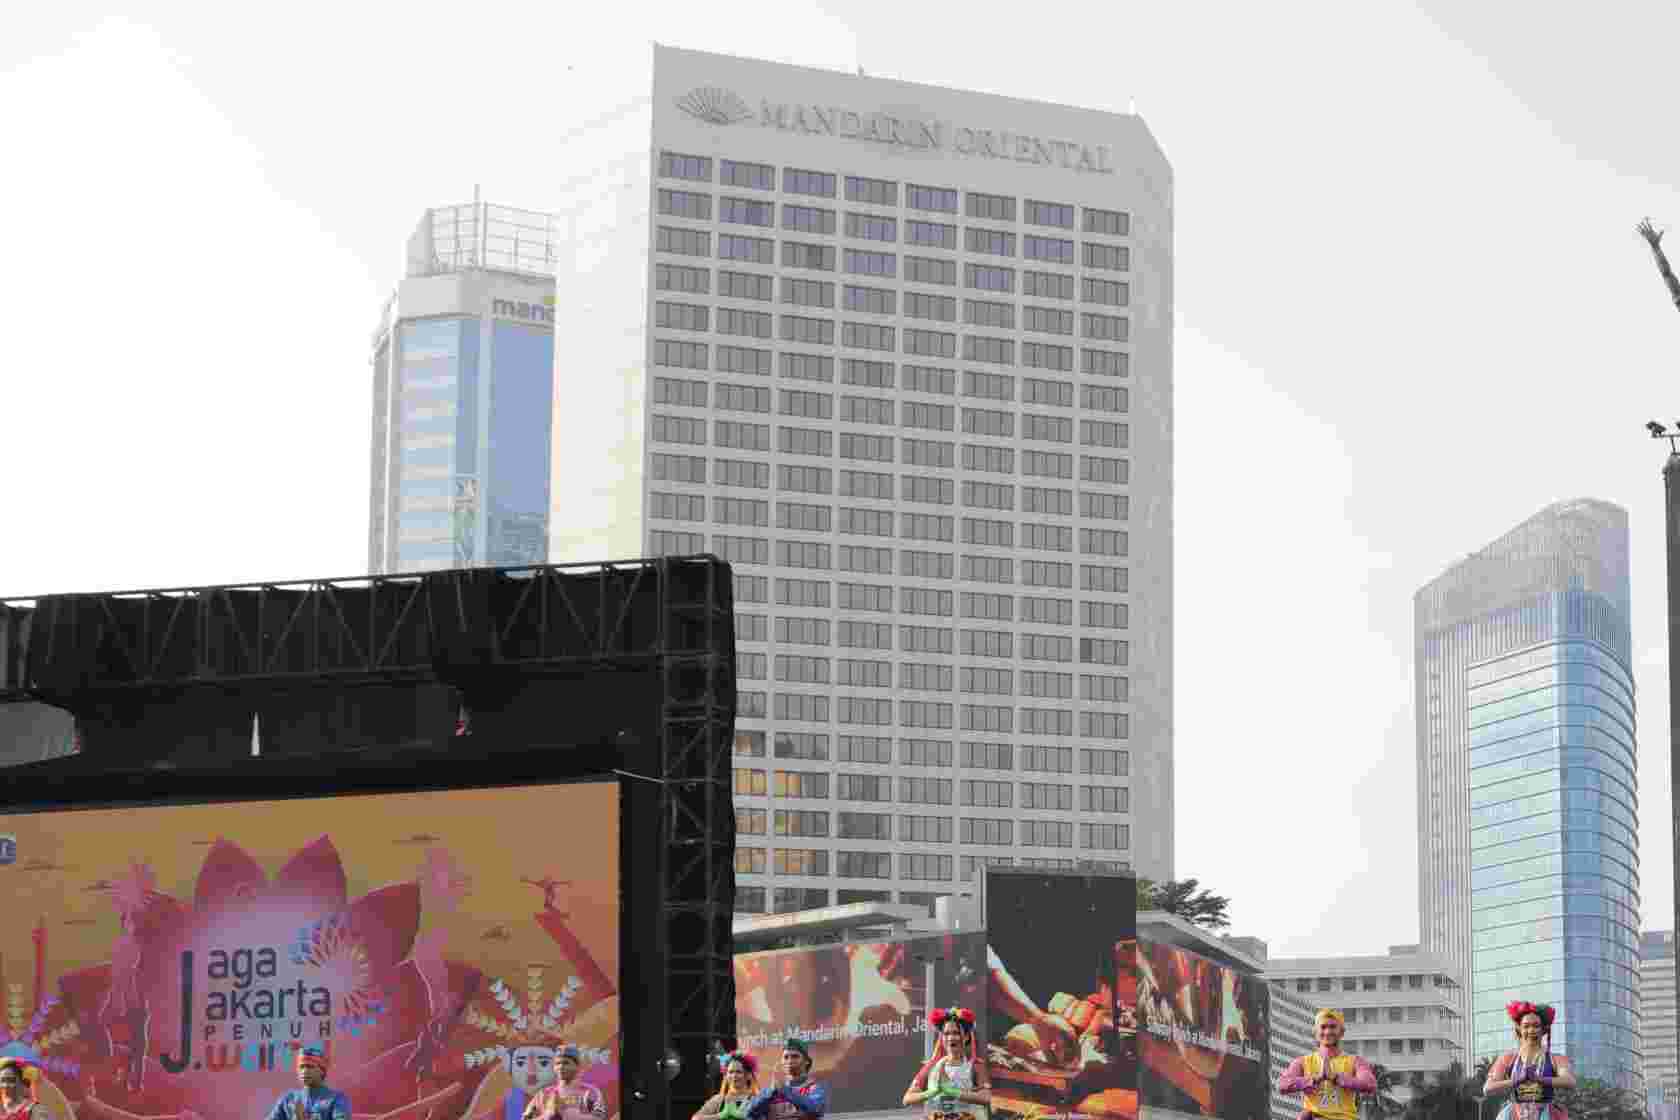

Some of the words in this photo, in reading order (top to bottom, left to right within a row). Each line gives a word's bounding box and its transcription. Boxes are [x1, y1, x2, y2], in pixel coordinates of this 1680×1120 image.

[757, 97, 944, 150] MANDARIN
[952, 128, 1118, 174] ORIENTAL
[205, 1021, 332, 1041] PENUH
